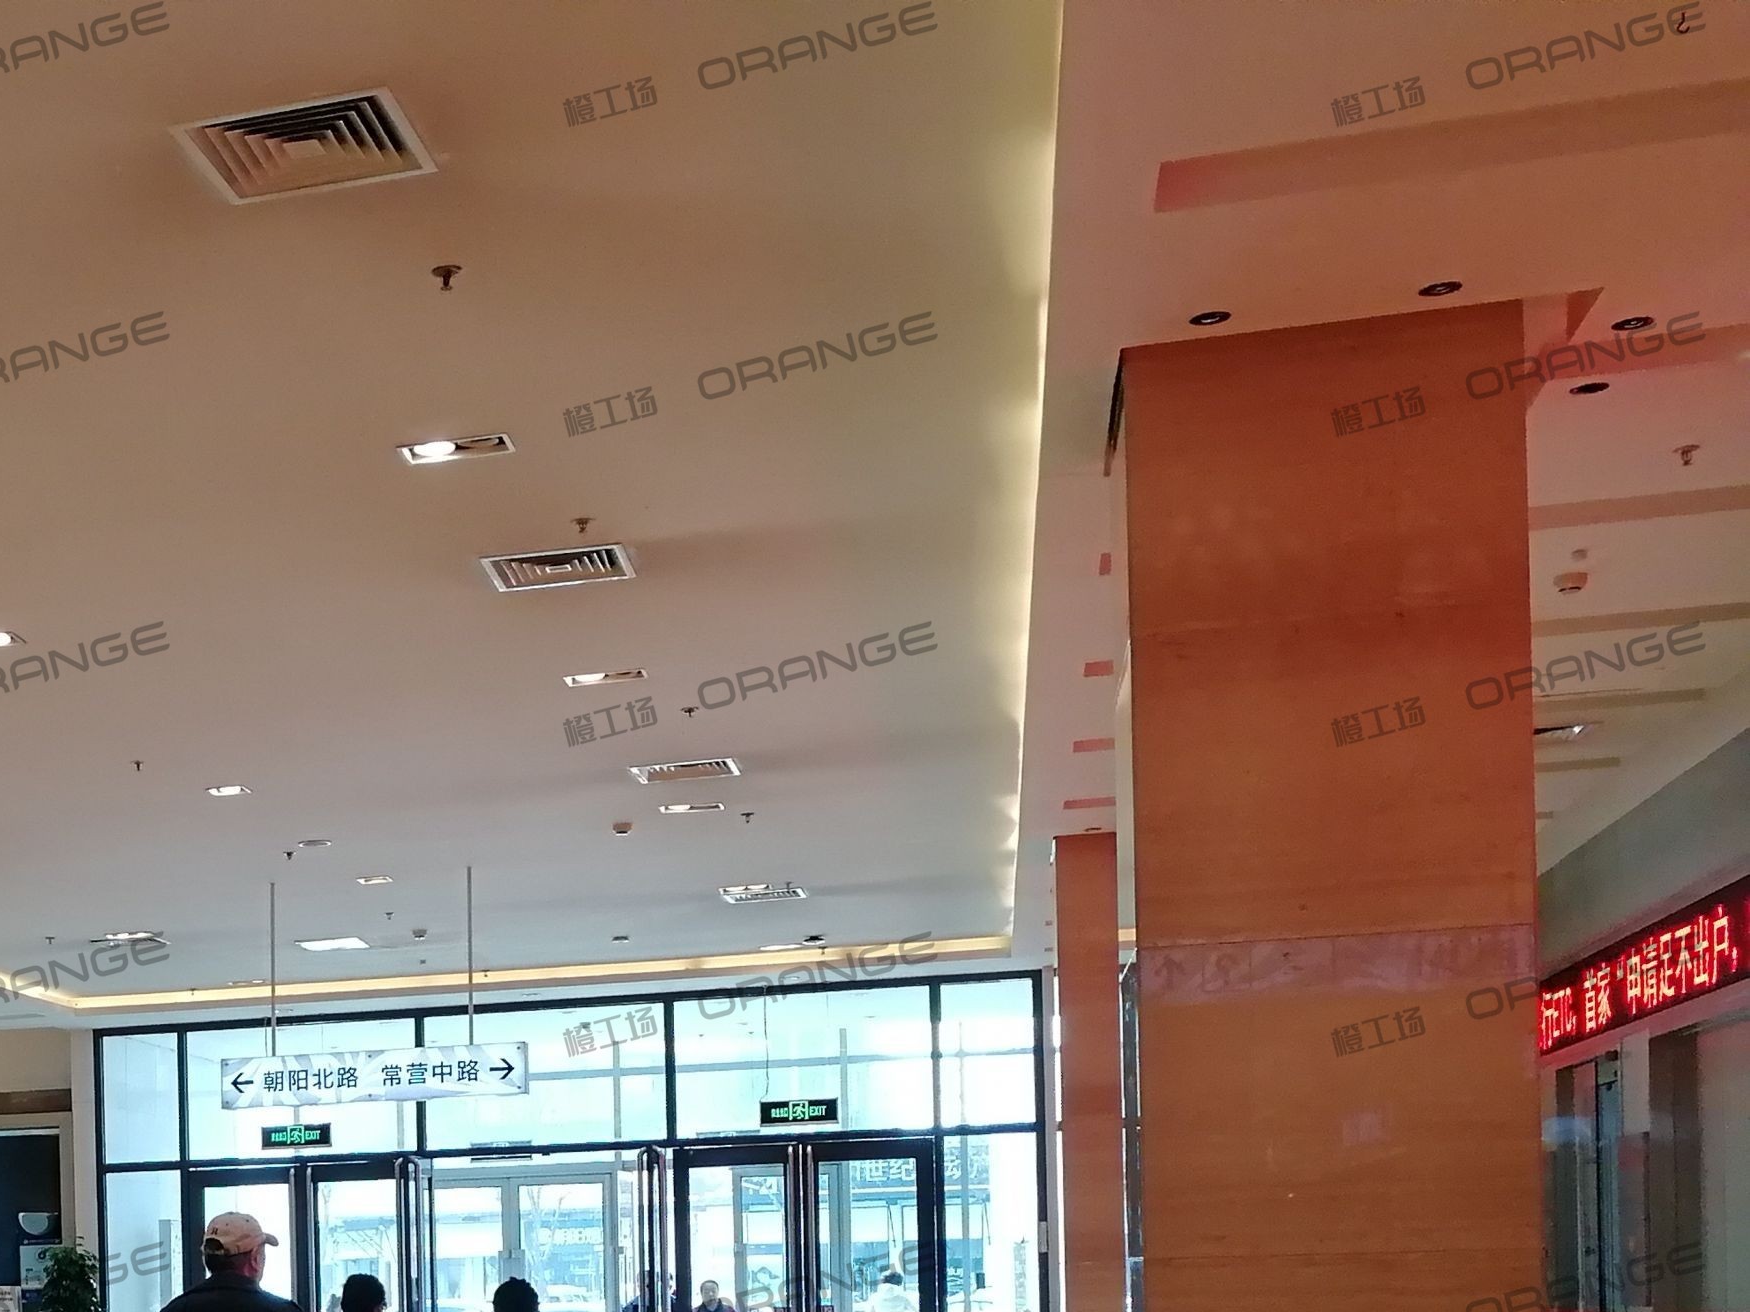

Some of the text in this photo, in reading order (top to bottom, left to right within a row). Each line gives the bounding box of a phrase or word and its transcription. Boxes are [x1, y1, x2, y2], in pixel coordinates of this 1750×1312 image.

[263, 1059, 480, 1092] 朝阳北路 常营中路
[810, 1106, 827, 1116] EXIT
[305, 1130, 321, 1140] EXIT
